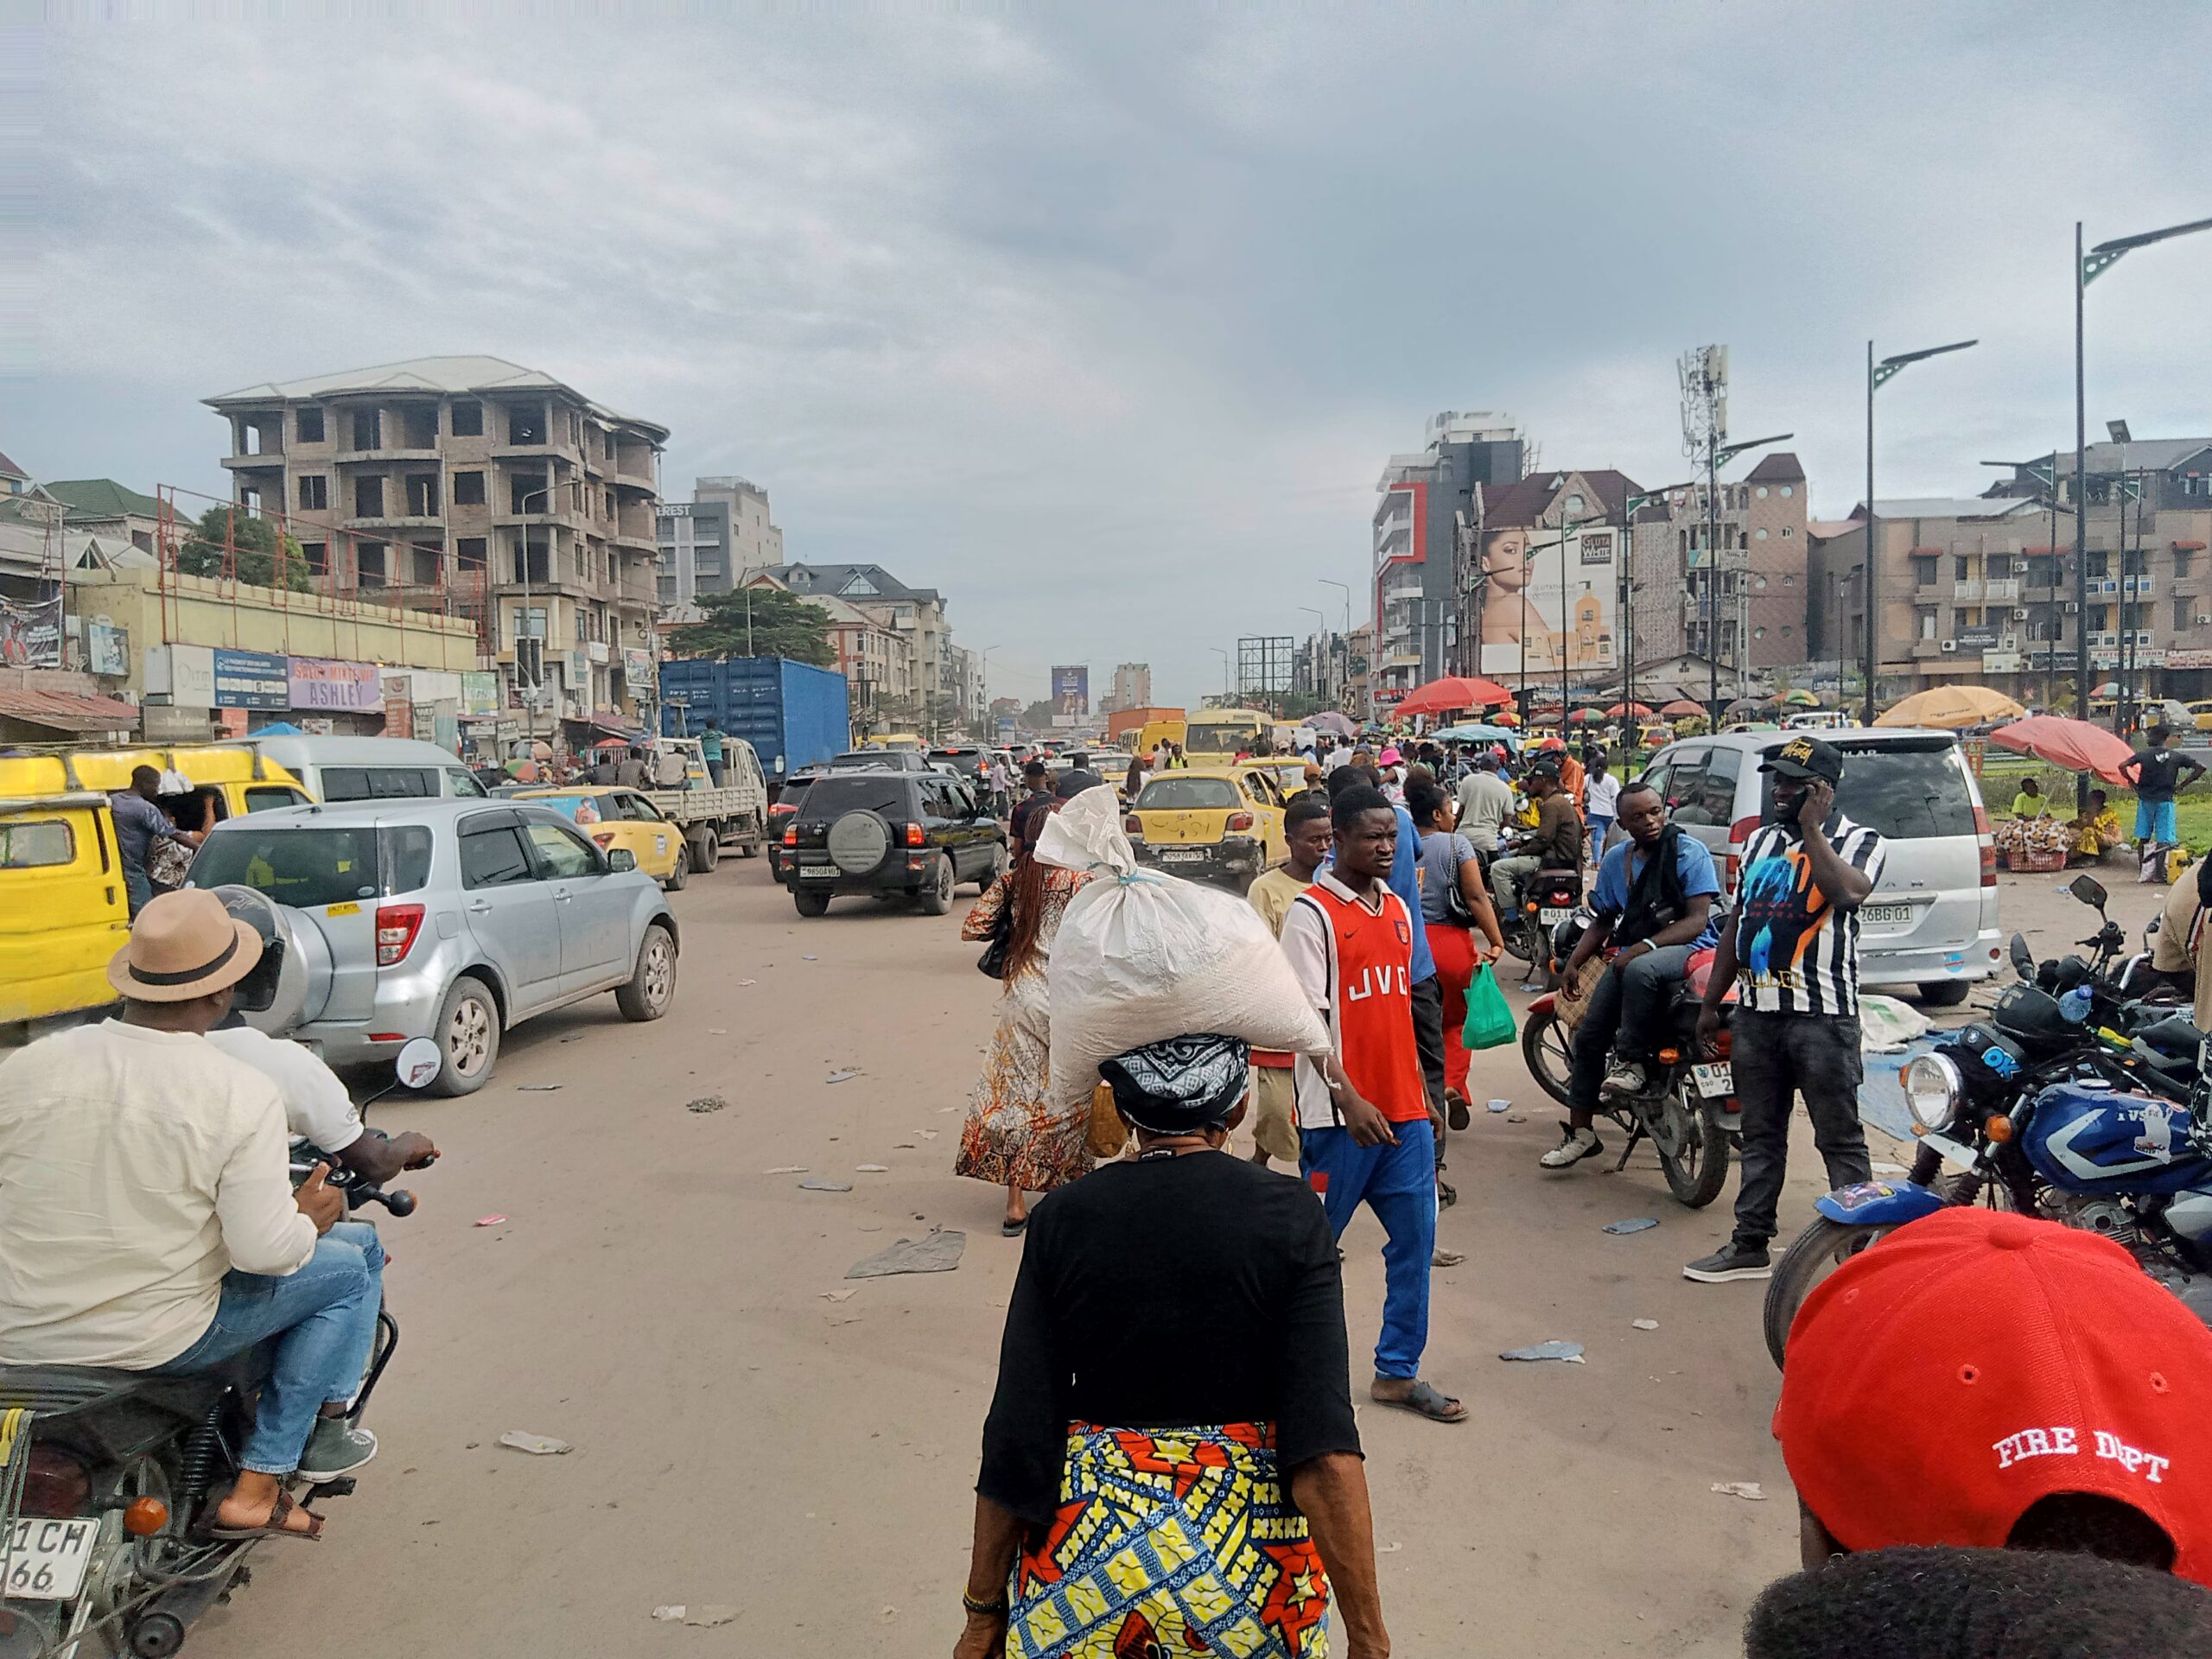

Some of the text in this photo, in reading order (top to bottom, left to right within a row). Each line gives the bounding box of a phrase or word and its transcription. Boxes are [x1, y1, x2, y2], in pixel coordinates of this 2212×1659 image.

[1582, 545, 1610, 558] WHITE
[1583, 537, 1610, 546] GLUTA
[310, 682, 363, 706] ASHLEY
[1894, 907, 1911, 921] 01
[1349, 965, 1408, 1001] JVC
[1711, 1063, 1732, 1078] 01
[1981, 1046, 2022, 1081] OK
[1992, 1427, 2078, 1469] FIRE
[1, 1558, 54, 1592] 66
